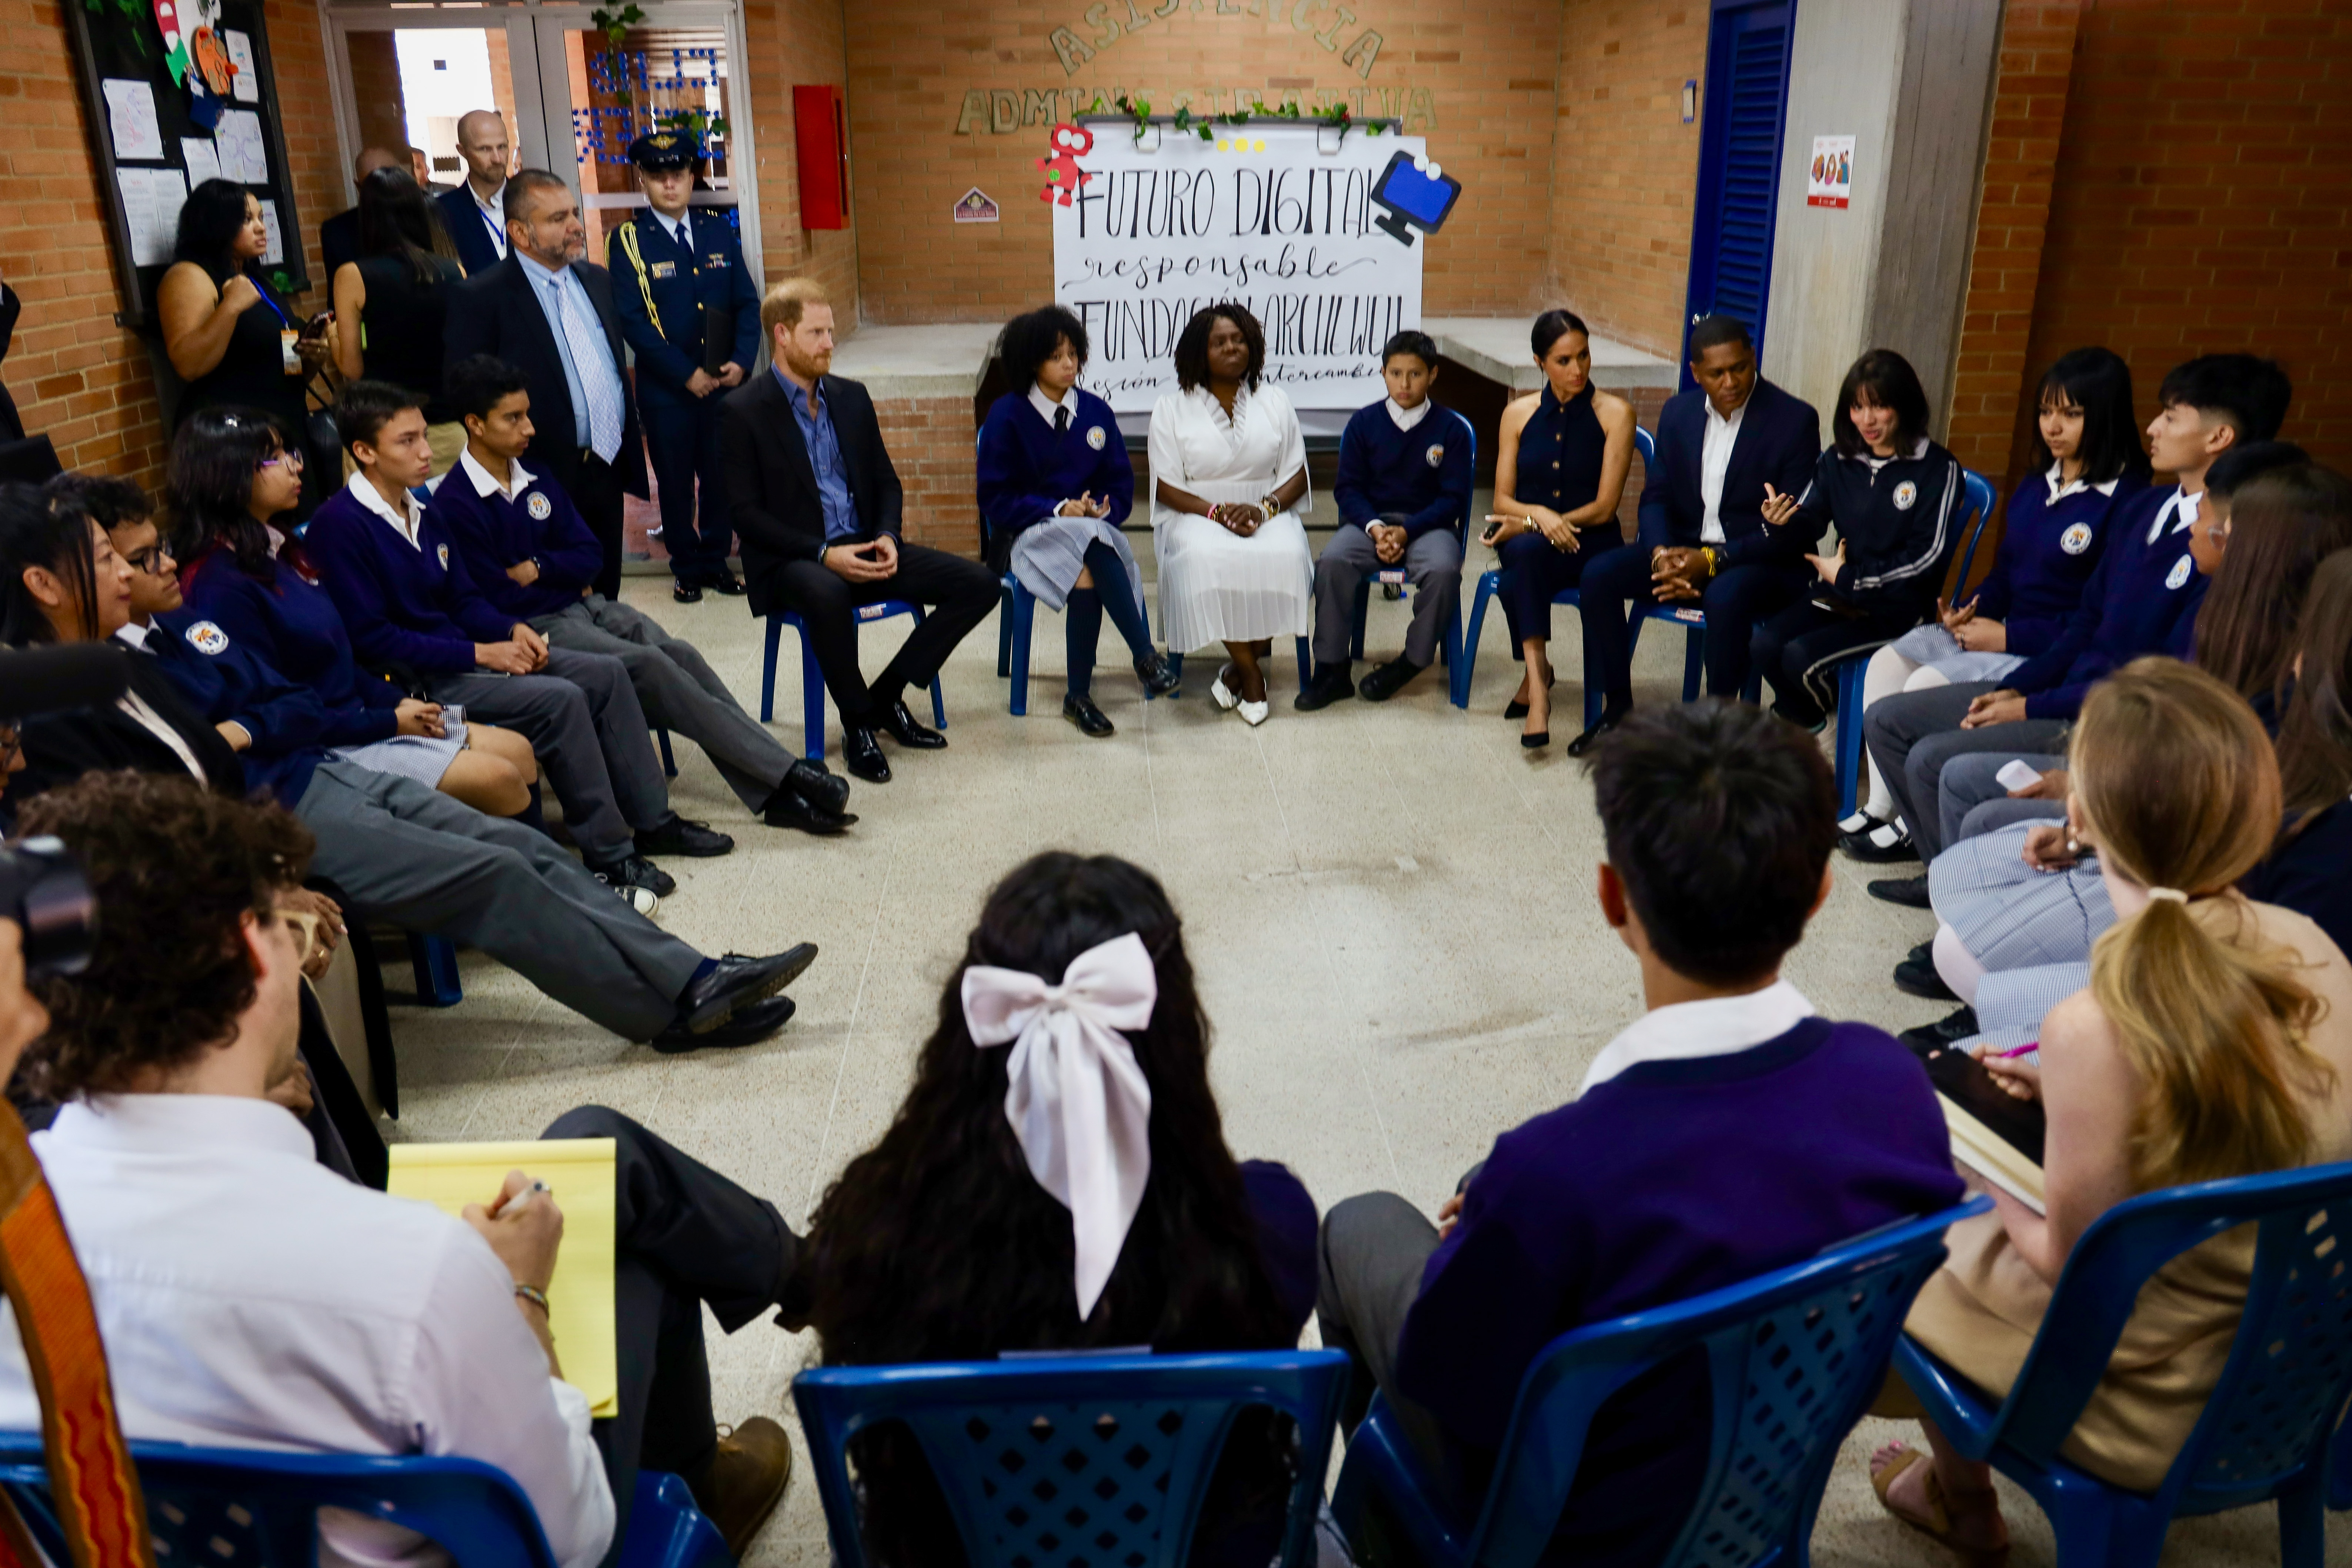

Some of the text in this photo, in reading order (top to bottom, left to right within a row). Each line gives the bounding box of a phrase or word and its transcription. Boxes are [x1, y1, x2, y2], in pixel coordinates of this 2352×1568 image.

[1077, 167, 1385, 239] FUTURO DIGITAL
[1062, 242, 1377, 290] responsable
[1074, 287, 1252, 363] FUNDA
[1260, 362, 1383, 385] ntercambi
